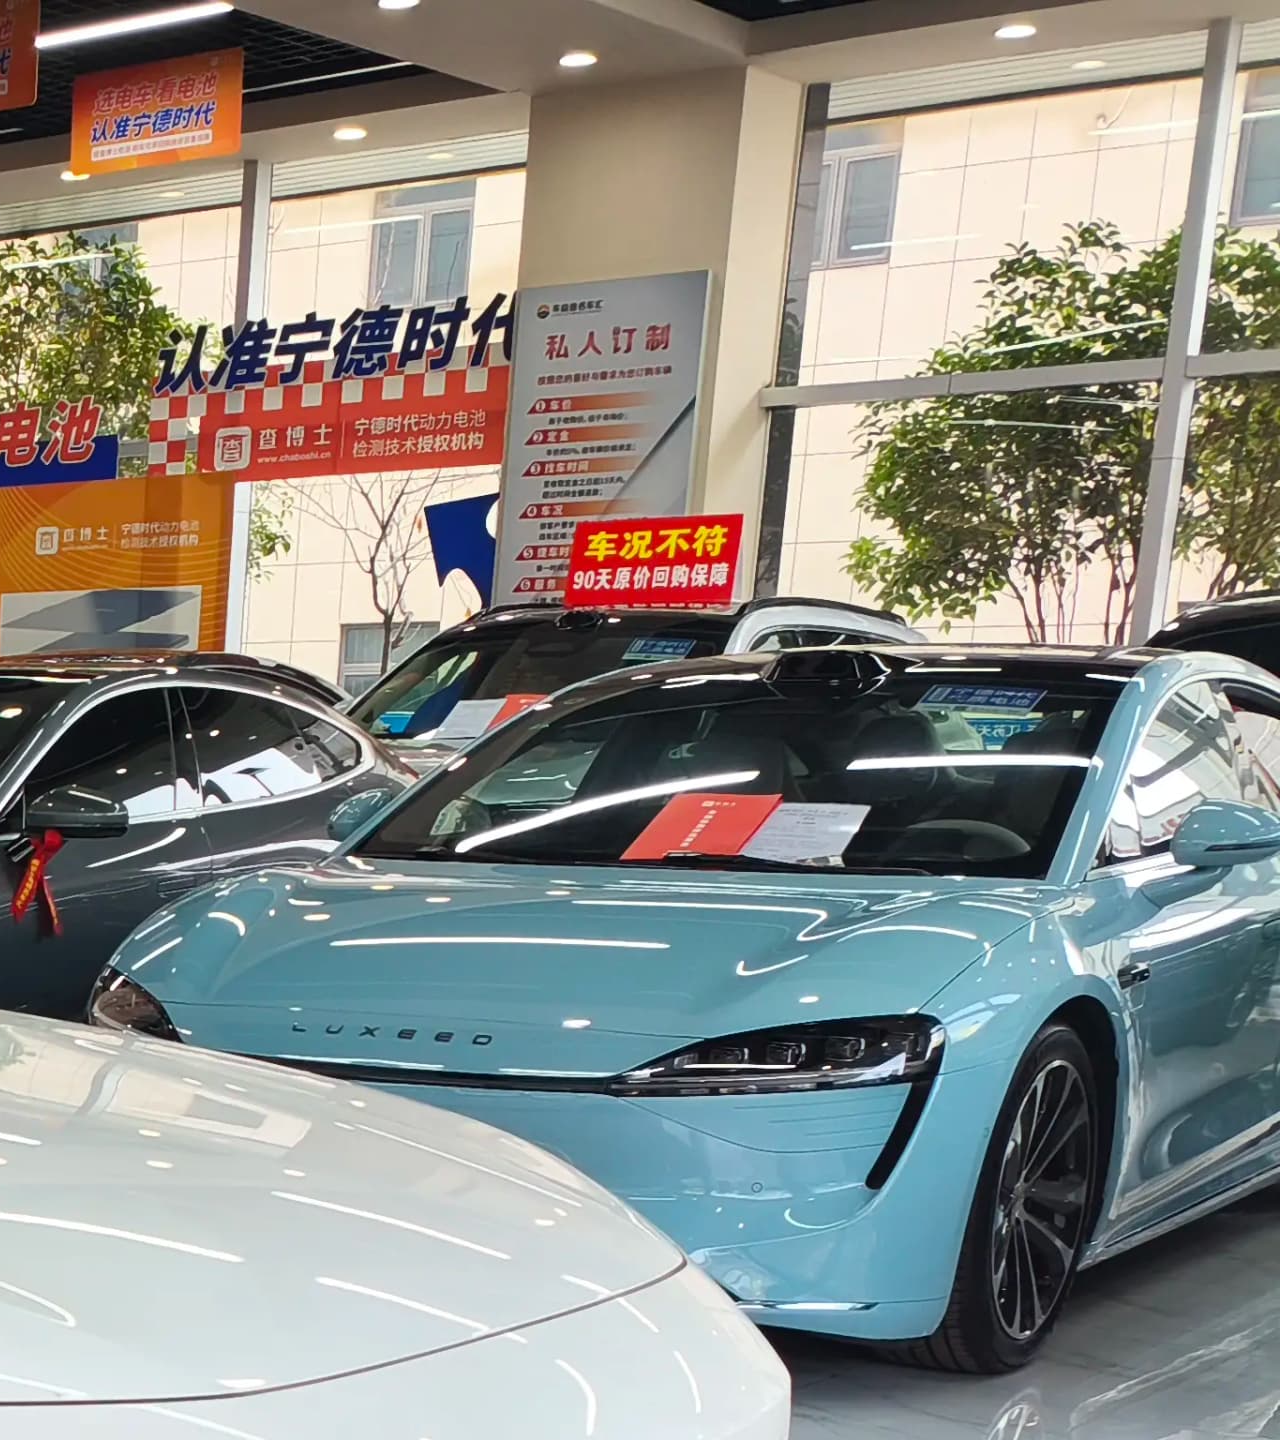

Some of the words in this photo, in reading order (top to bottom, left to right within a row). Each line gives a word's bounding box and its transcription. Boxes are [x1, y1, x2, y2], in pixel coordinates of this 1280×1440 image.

[94, 73, 217, 113] 选电车看电池
[91, 101, 216, 144] 认准宁德时代
[154, 293, 518, 396] 认准宁德时代
[545, 323, 672, 361] 私人订制
[257, 424, 333, 450] 查博士
[353, 409, 486, 437] 宁德时代动力电池
[257, 450, 332, 465] www.chaboshi.cn
[352, 431, 485, 458] 检测技术授权机构
[544, 460, 590, 474] 找车时间
[541, 504, 564, 516] 车况
[583, 525, 729, 562] 车况不符
[572, 563, 729, 591] 90天原价回购保障
[291, 1023, 493, 1046] LUXEED
